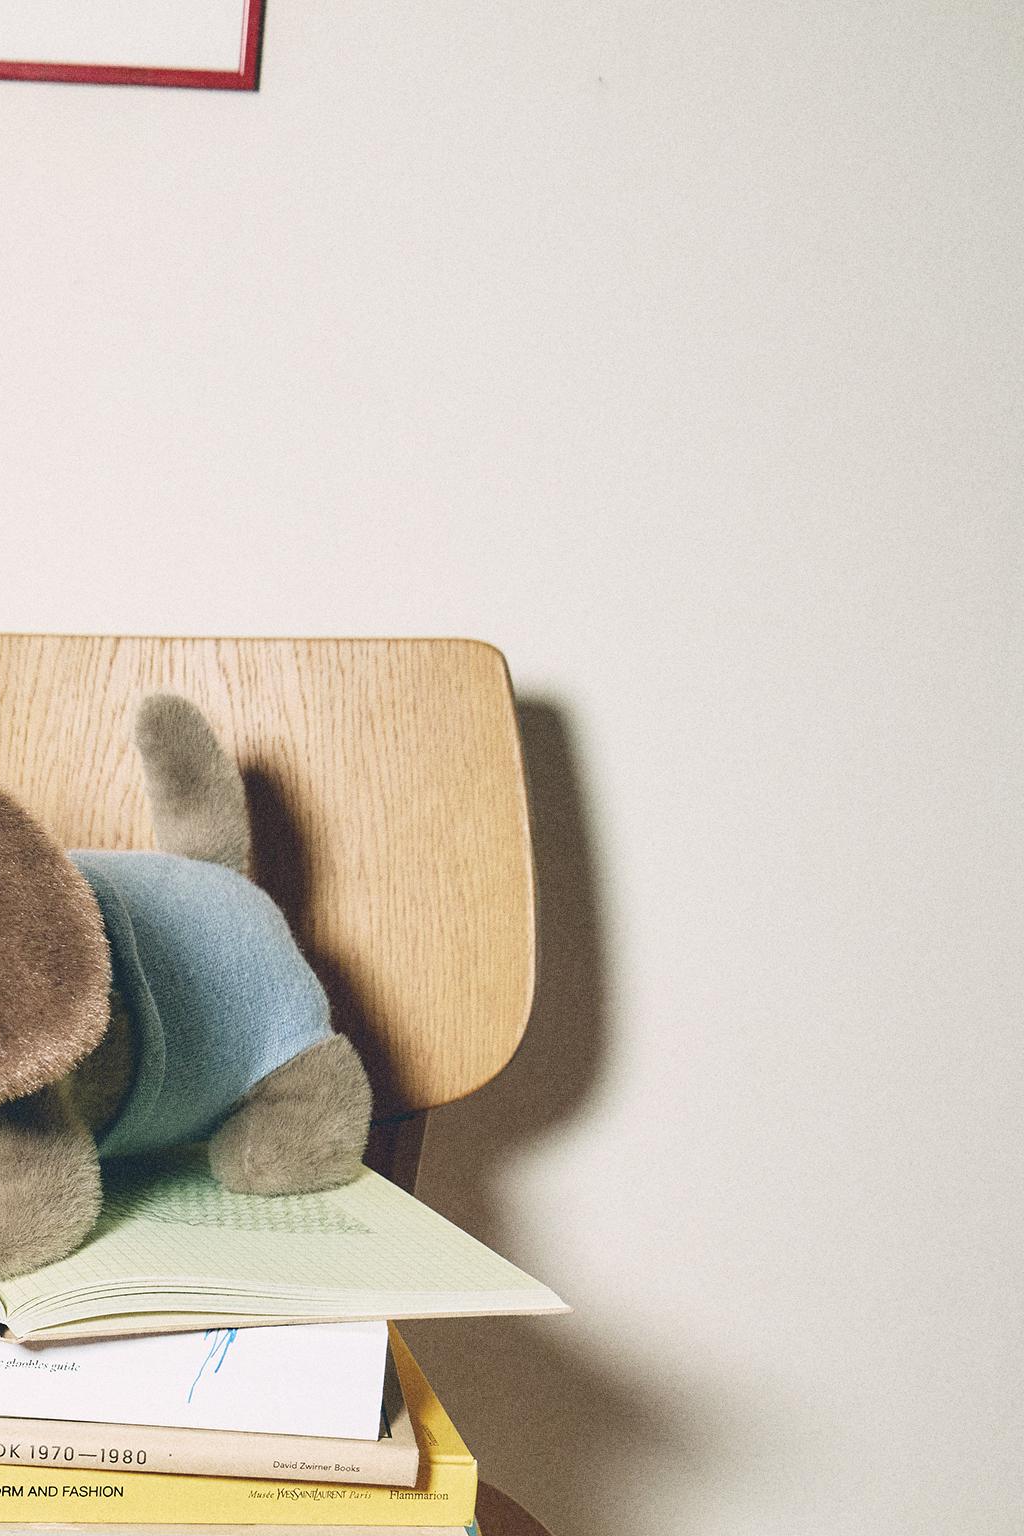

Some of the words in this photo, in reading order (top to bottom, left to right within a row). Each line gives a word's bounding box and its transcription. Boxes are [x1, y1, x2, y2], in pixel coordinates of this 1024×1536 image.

[49, 1361, 81, 1373] guide
[273, 1460, 298, 1471] David
[299, 1462, 332, 1472] Zwirner
[334, 1464, 361, 1474] Books
[26, 1485, 59, 1498] AND
[62, 1485, 125, 1498] FASHION
[247, 1488, 275, 1499] Musée
[348, 1490, 373, 1500] Paris
[389, 1490, 450, 1501] Flammarion
